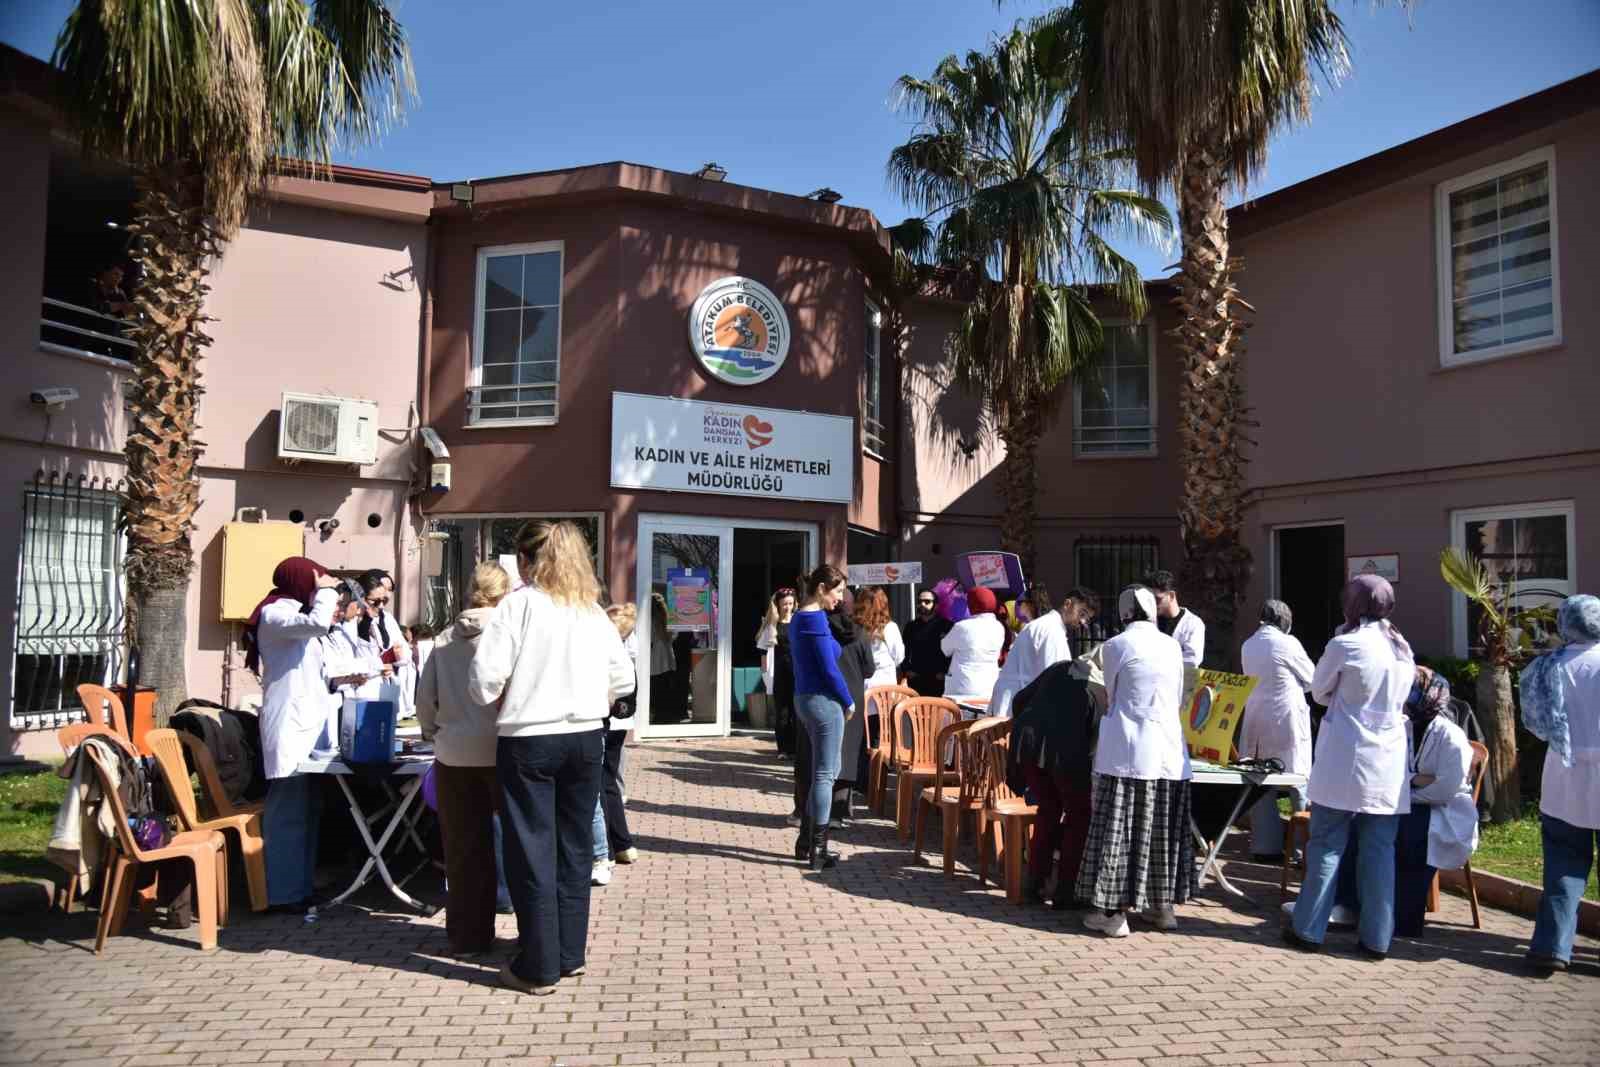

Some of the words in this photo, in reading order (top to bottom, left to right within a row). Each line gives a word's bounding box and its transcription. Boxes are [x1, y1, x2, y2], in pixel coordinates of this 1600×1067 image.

[705, 296, 733, 346] ATAKUM
[703, 416, 742, 429] KADIN
[635, 446, 685, 464] KADIN
[690, 451, 709, 466] VE
[713, 451, 745, 469] AİLE
[750, 453, 831, 476] HİZMETLERİ
[687, 470, 783, 492] MÜDÜRLÜĞÜ
